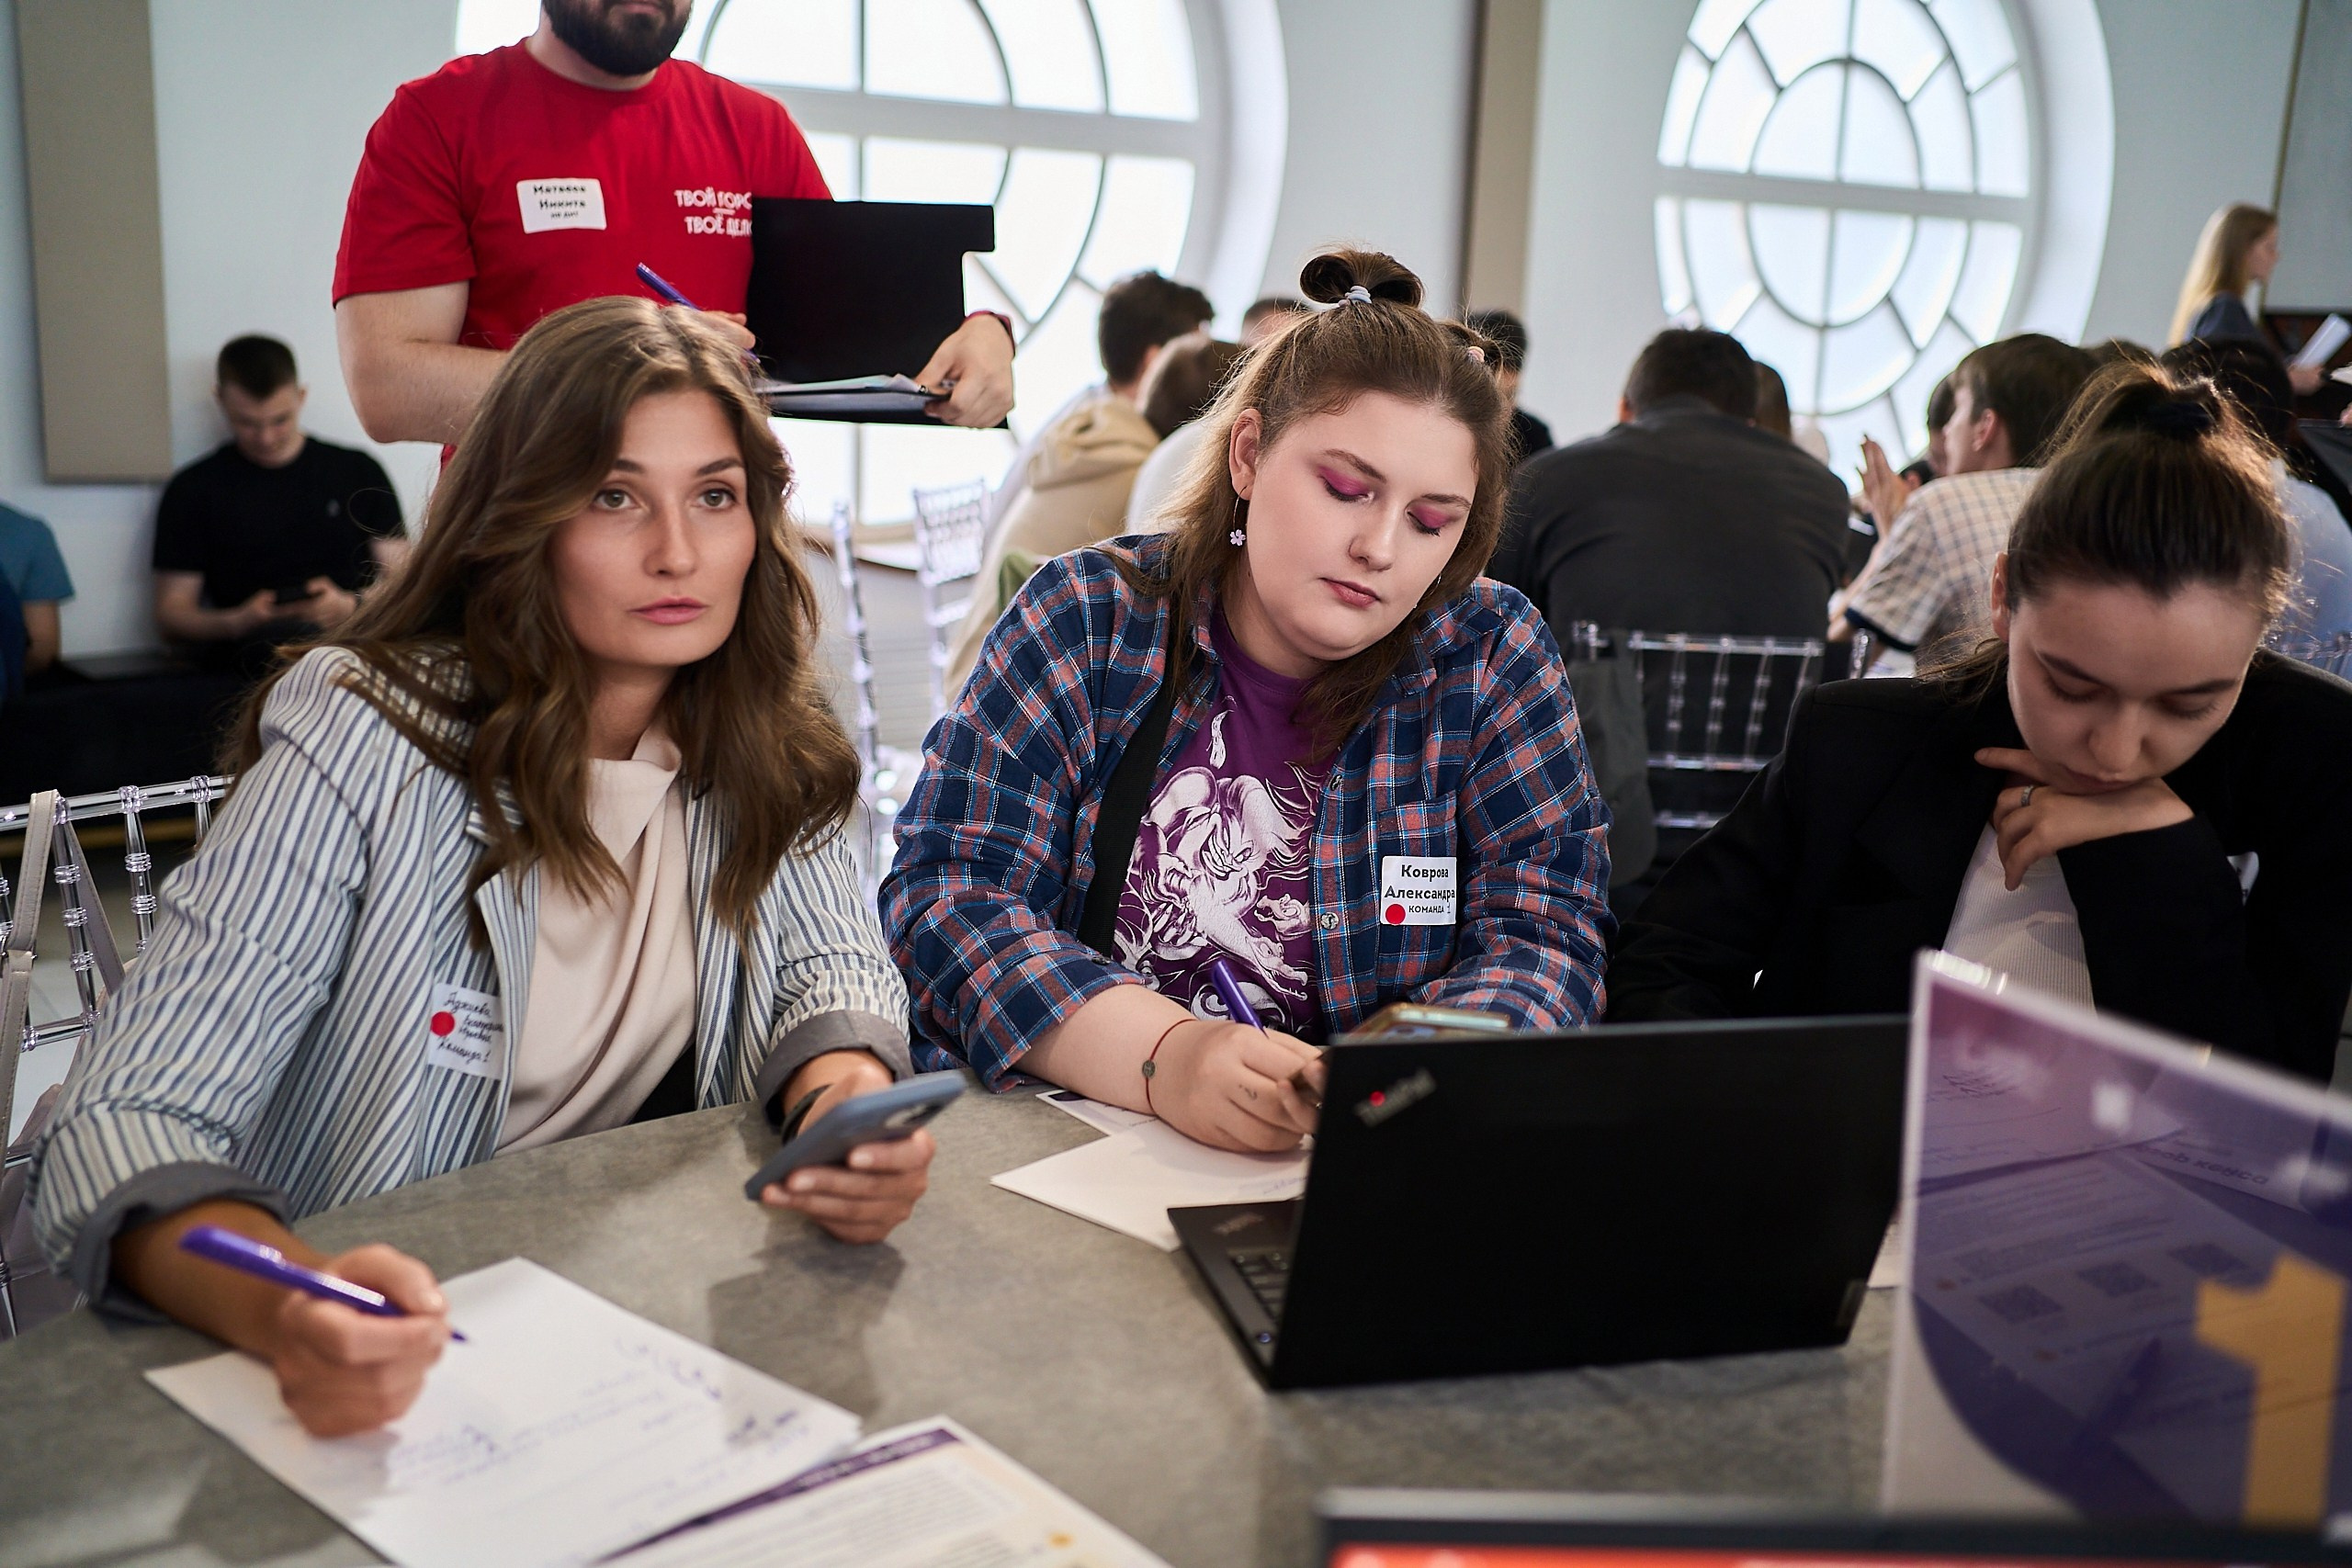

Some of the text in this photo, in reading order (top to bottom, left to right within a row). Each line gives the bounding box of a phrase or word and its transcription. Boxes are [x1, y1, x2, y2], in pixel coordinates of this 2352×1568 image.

[673, 186, 717, 208] ТВОЙ
[684, 212, 752, 239] ТВОЁ ДЕЛ
[1401, 864, 1449, 882] Коврова
[1384, 886, 1455, 902] Александра
[2196, 1255, 2346, 1523] 1
